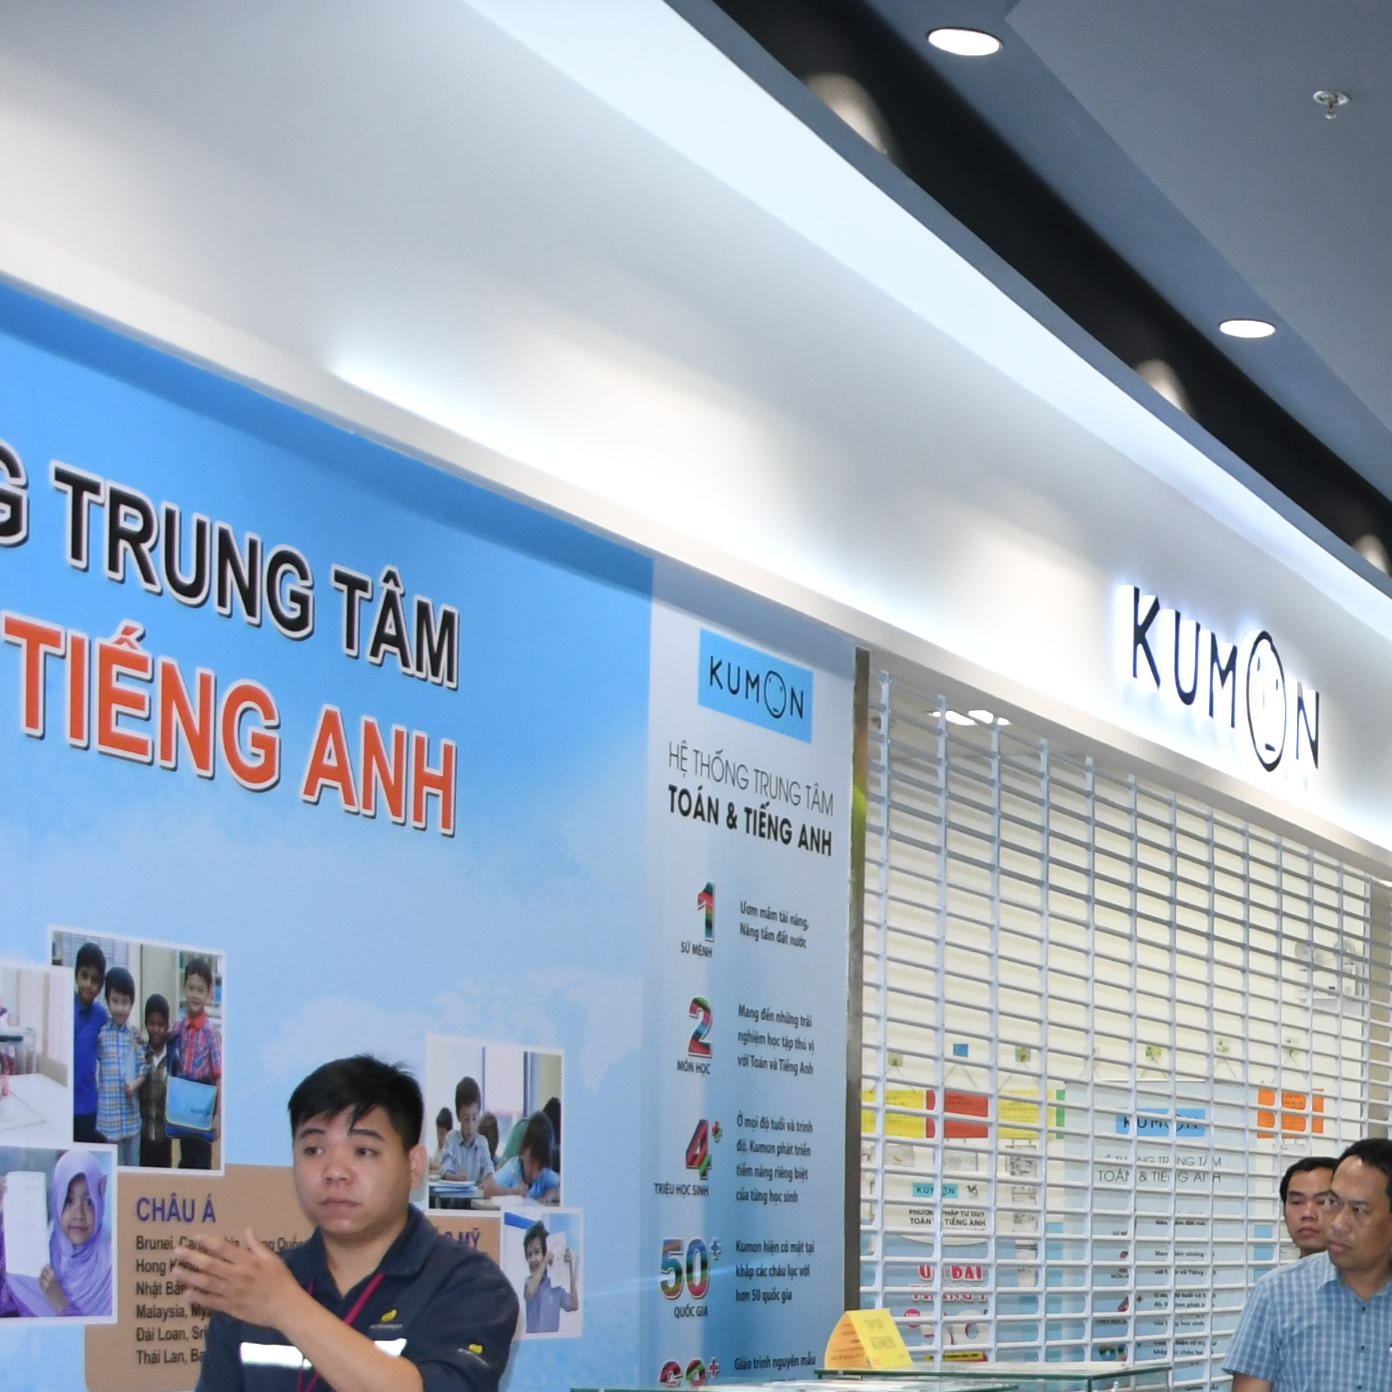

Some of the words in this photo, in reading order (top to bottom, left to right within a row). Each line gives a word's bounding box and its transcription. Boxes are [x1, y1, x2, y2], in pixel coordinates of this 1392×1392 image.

[53, 464, 312, 634] TRUNG
[333, 567, 457, 687] TÂM
[709, 656, 804, 719] KUMON
[1132, 586, 1320, 772] KUMON
[4, 616, 279, 785] TIẾNG
[303, 708, 456, 832] ANH
[669, 740, 688, 779] HỆ
[693, 749, 749, 790] THỐNG
[754, 768, 801, 807] TRUNG
[806, 782, 834, 816] TÂM
[668, 784, 719, 825] TOÁN
[726, 802, 738, 830] &
[744, 802, 792, 846] TIẾNG
[798, 823, 832, 856] ANH
[697, 881, 715, 942] 1
[687, 995, 713, 1059] 2
[749, 1141, 776, 1154] Kumon
[136, 1192, 195, 1222] CHÂU
[202, 1193, 216, 1223] Á
[136, 1259, 166, 1276] Hong
[736, 1240, 763, 1253] Kumon
[136, 1281, 162, 1300] Nhật
[136, 1350, 160, 1364] Thái
